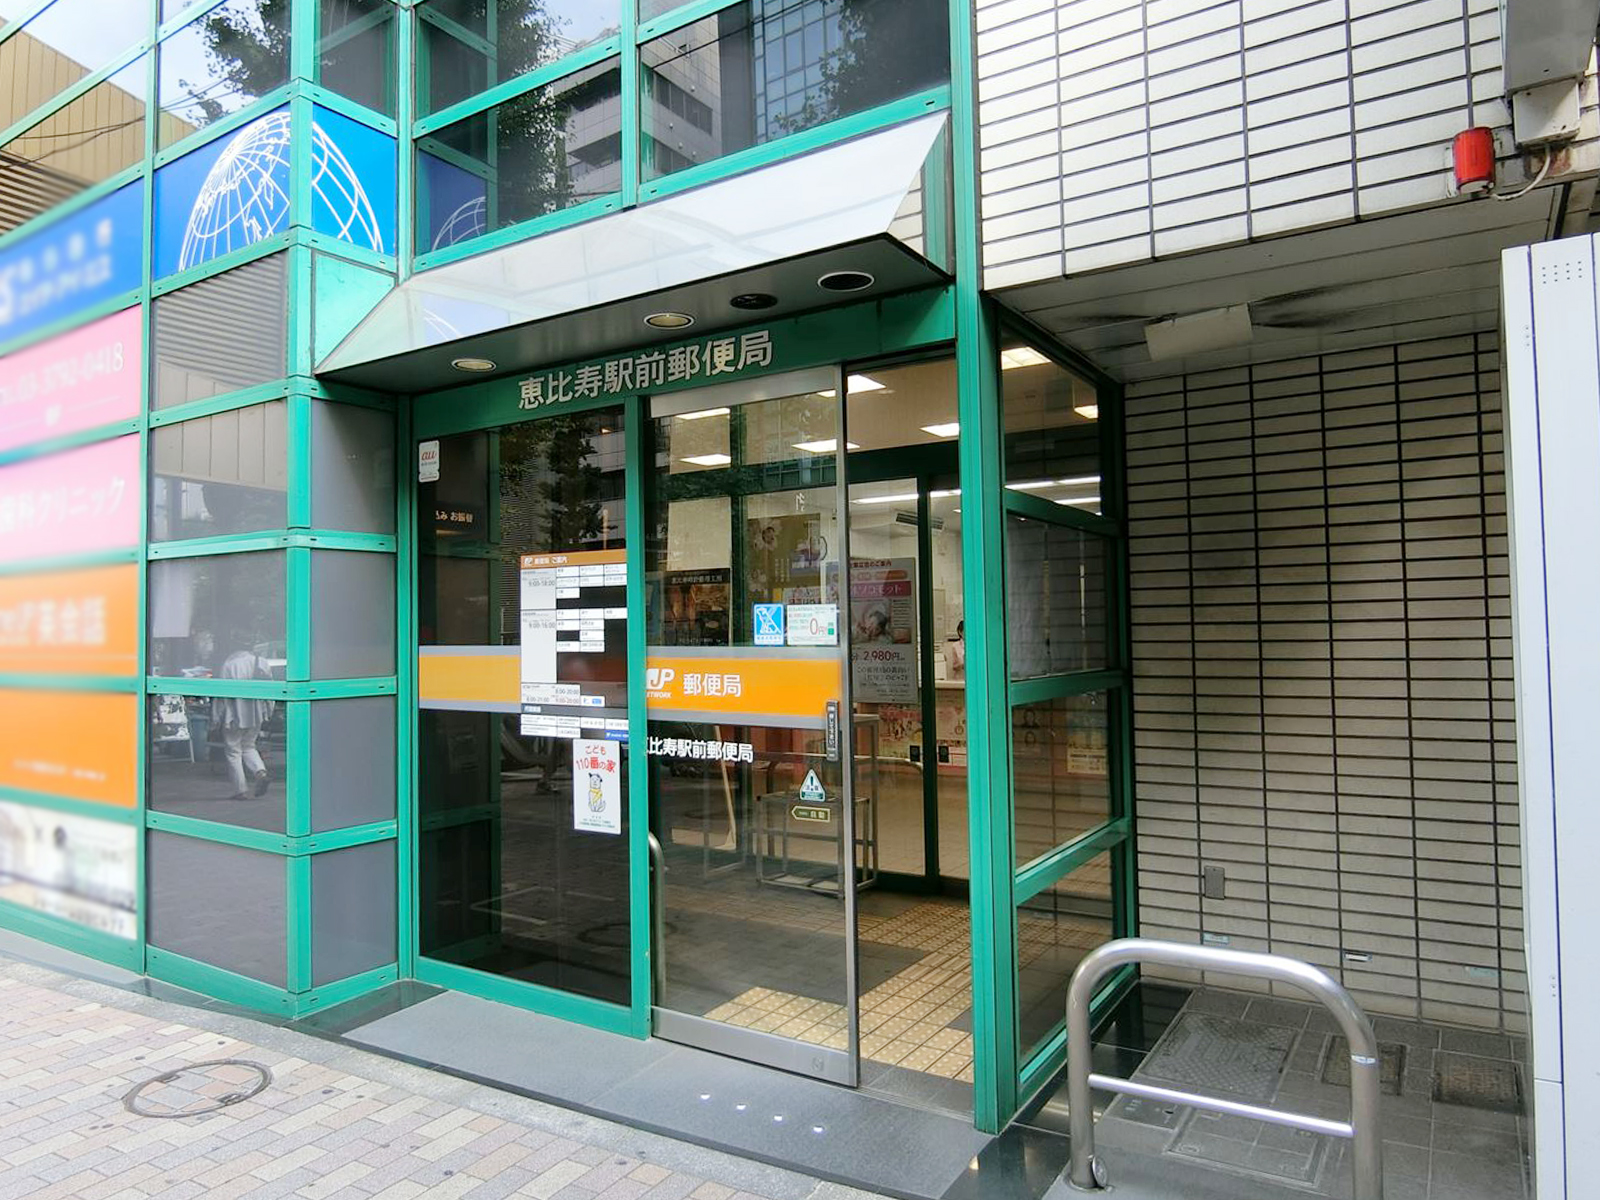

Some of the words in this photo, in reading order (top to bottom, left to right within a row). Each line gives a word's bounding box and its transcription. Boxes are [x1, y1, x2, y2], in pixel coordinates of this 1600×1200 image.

[518, 330, 773, 410] 恵比寿駅前郵便局
[421, 451, 437, 461] au
[863, 650, 900, 661] 2,980円
[683, 673, 742, 698] 郵便局
[646, 691, 672, 699] ETWORK
[585, 744, 607, 755] こども
[646, 736, 754, 763] 比寿駅前郵便局
